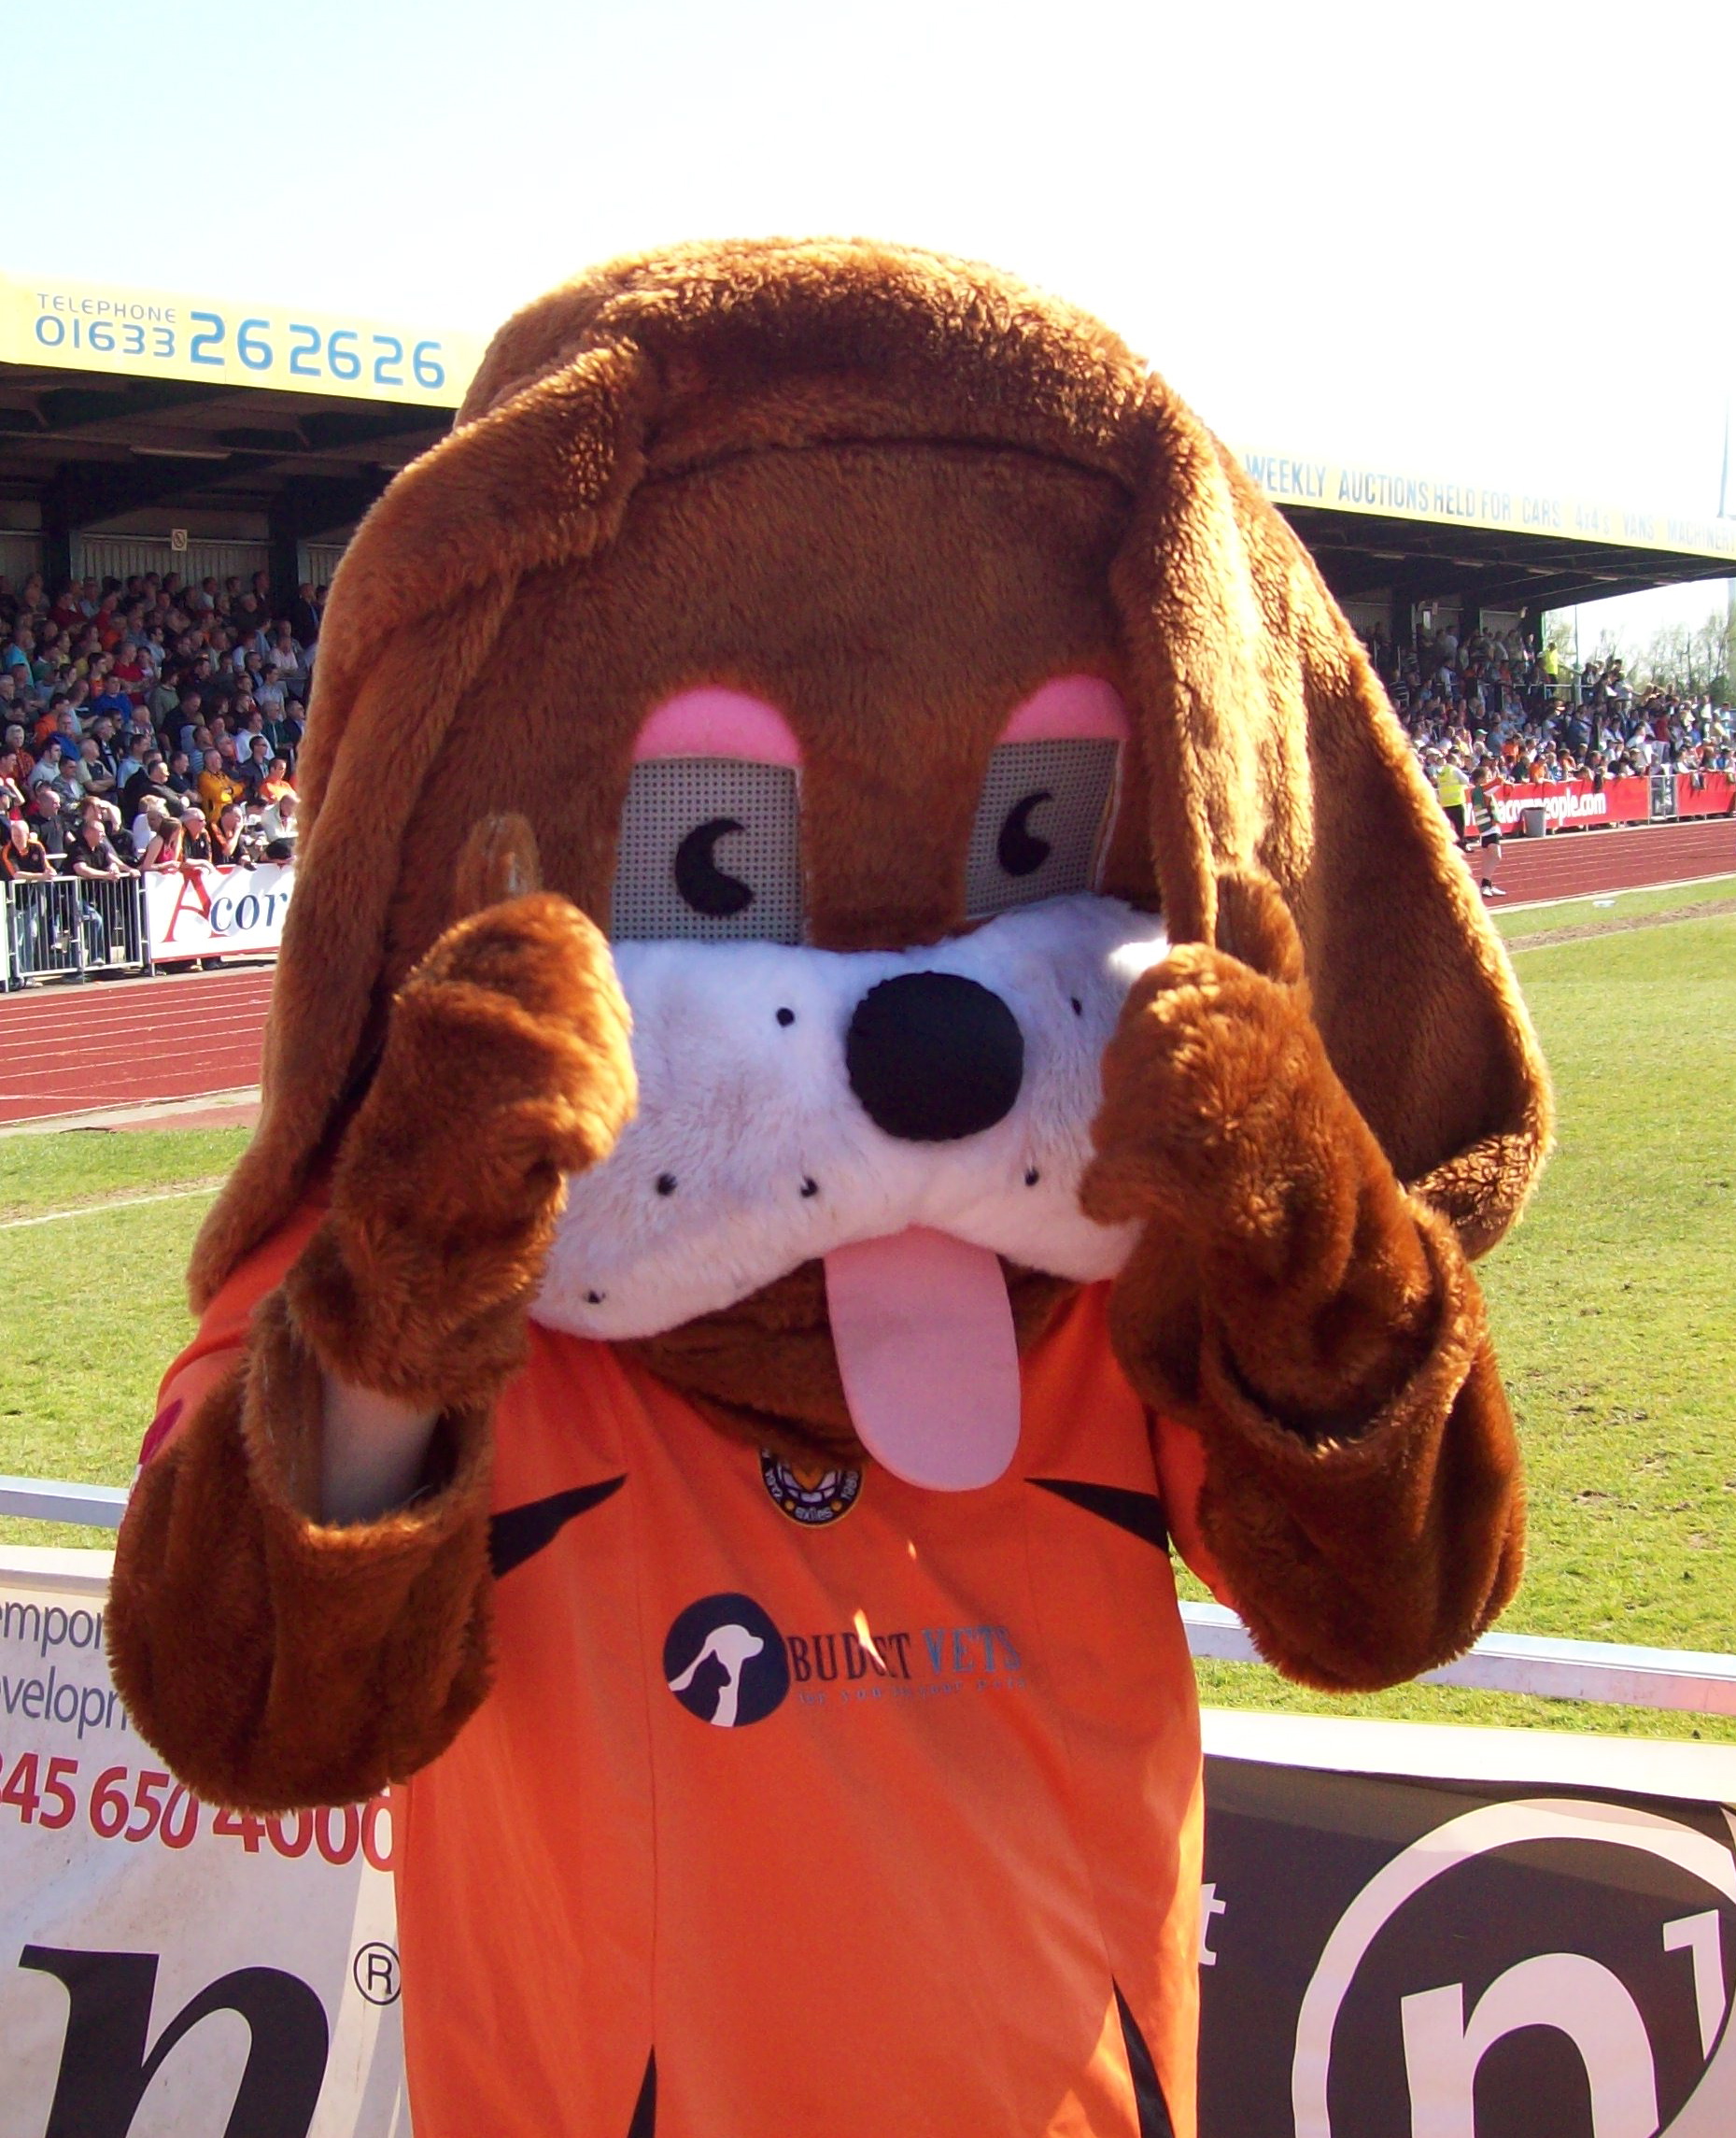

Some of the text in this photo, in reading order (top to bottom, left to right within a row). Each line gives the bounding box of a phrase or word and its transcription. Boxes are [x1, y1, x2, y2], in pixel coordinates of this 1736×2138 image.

[37, 293, 176, 323] TELEPHONE
[35, 315, 176, 358] 01633
[1245, 454, 1326, 498] WEEKLY
[1338, 469, 1429, 512] AUCTIONS
[1433, 483, 1475, 517] HELD
[1481, 489, 1511, 522] FOR
[1522, 496, 1562, 529] CARS
[0, 1601, 106, 1658] mpor
[921, 1624, 1022, 1676] VETS
[0, 1752, 78, 1830] 45
[90, 1766, 200, 1850] 650
